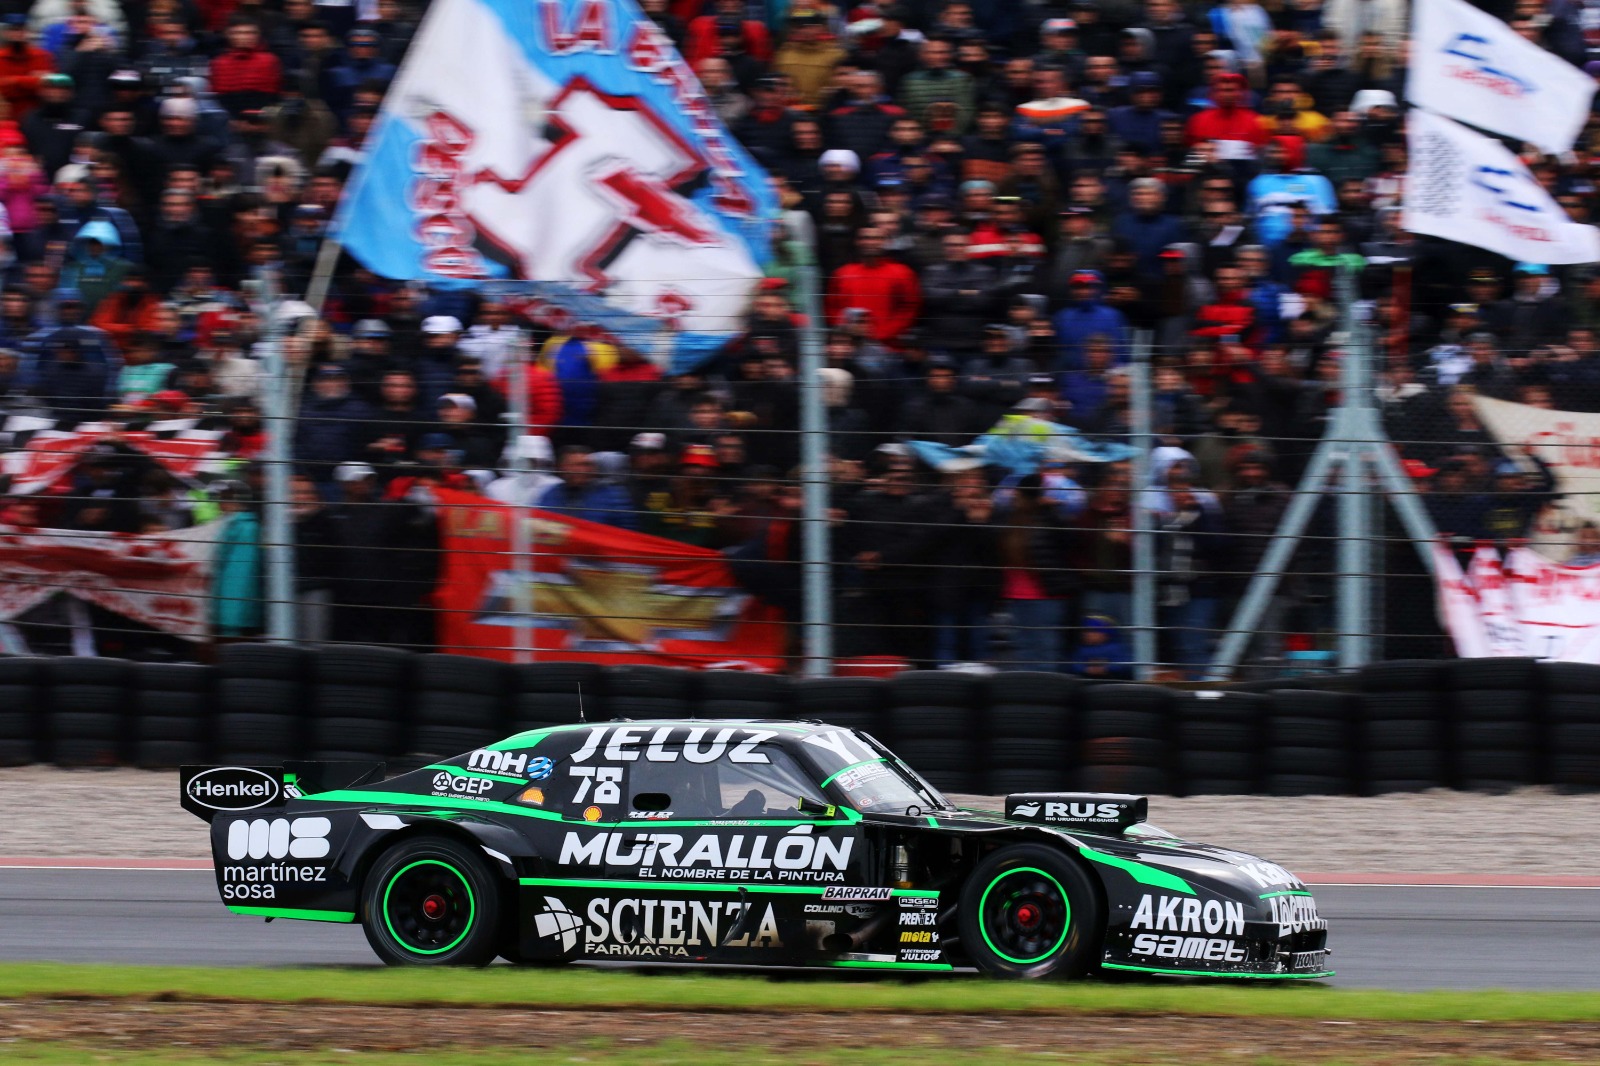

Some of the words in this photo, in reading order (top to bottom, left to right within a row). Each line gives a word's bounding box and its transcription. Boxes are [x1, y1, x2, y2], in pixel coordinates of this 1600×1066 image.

[569, 726, 780, 764] JELUZ
[195, 780, 270, 796] Henkel
[451, 776, 494, 795] GEP
[569, 766, 624, 804] 78
[558, 825, 854, 870] MURALLÓN
[223, 861, 326, 882] martínez
[638, 867, 657, 878] EL
[661, 868, 725, 879] NOMBRE
[729, 870, 750, 880] DE
[753, 870, 774, 880] LA
[778, 871, 845, 882] PINTURA
[223, 883, 276, 899] sosa
[825, 887, 890, 898] BARPRAN
[803, 904, 844, 913] COLLINO
[1130, 894, 1245, 935] AKRON
[585, 897, 784, 947] SCIENZA
[584, 943, 689, 957] FARMACIA
[902, 953, 931, 961] JULIO
[1132, 933, 1246, 962] samet
